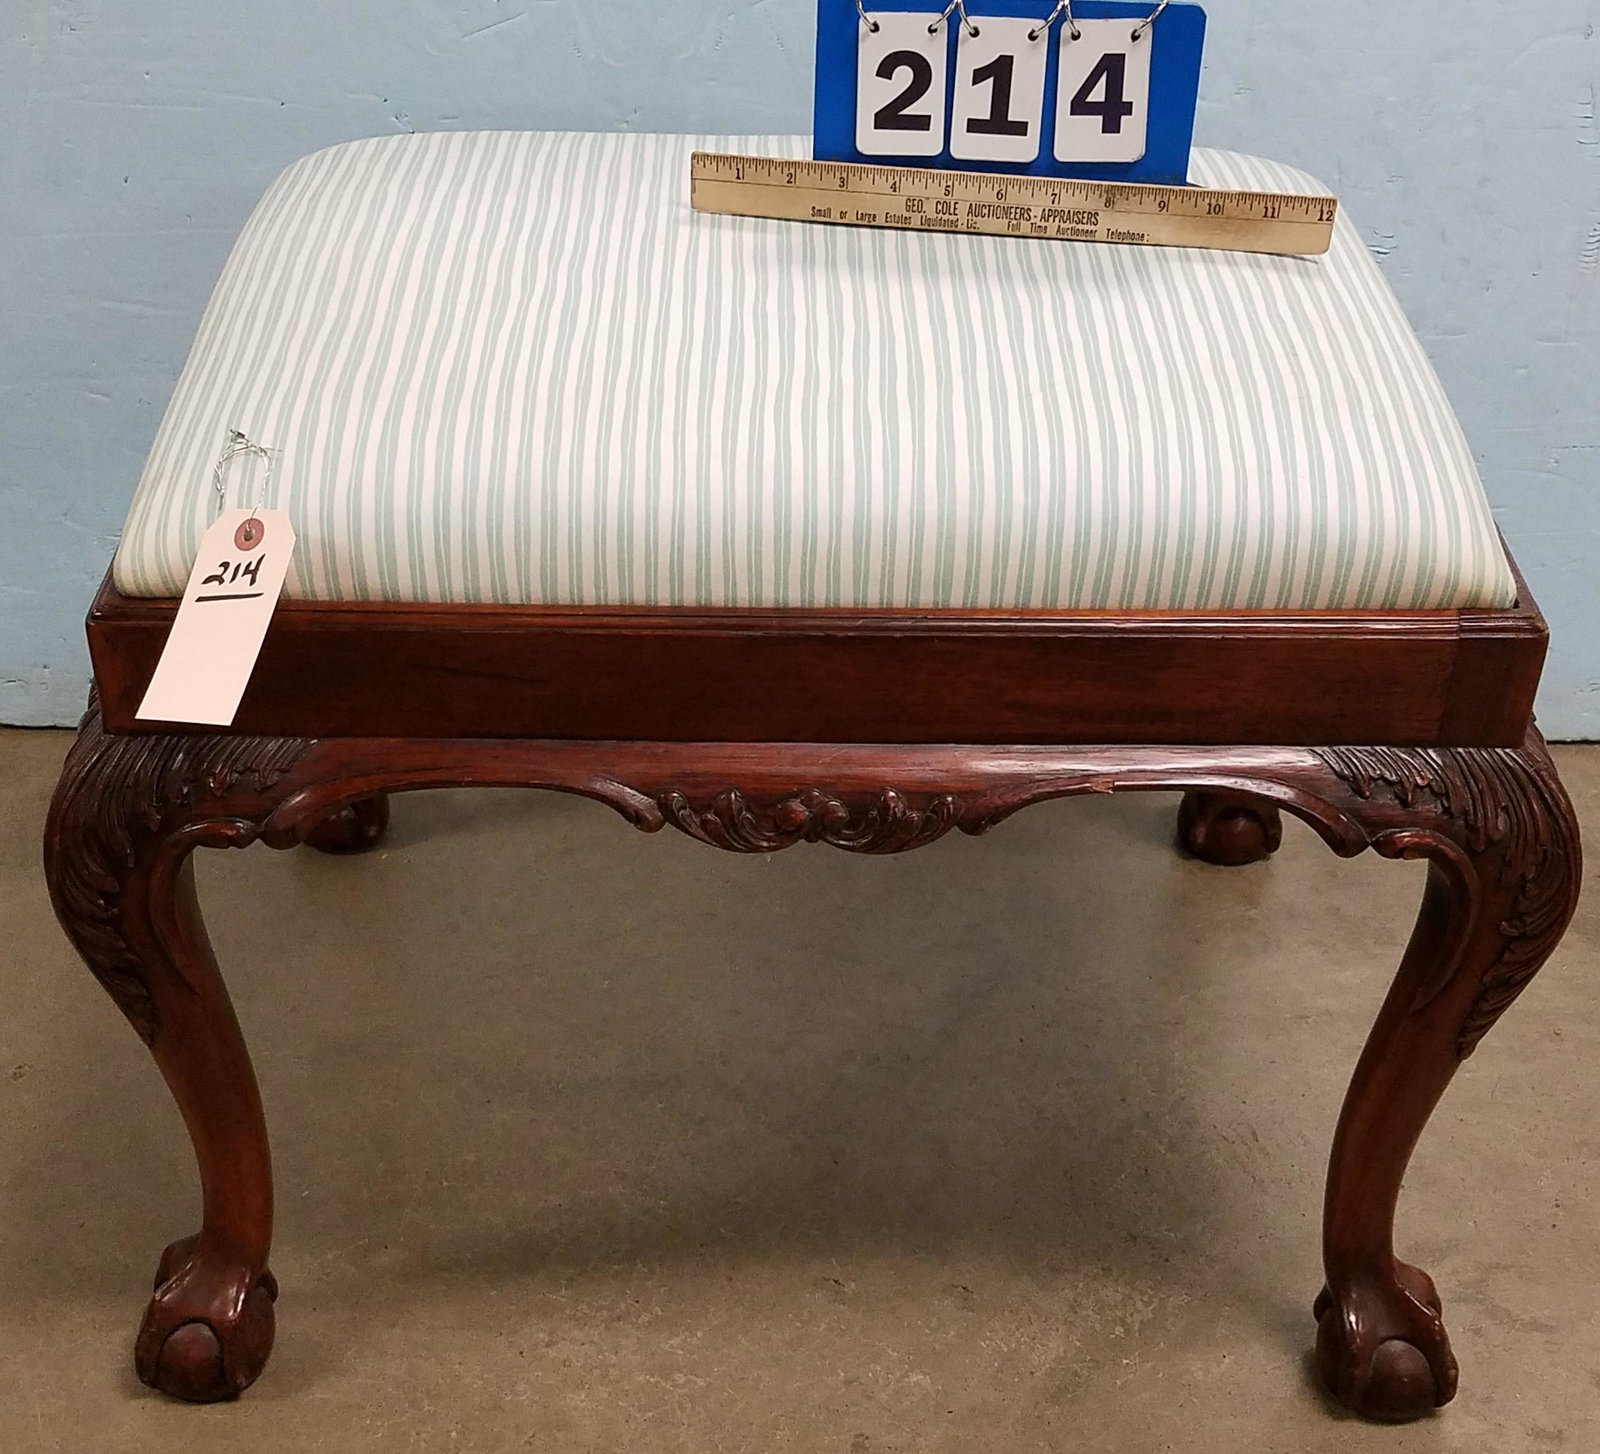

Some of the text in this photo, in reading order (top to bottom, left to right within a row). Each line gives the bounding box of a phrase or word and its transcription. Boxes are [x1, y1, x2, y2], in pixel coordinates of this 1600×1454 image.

[735, 167, 1333, 222] 1 2 3 4 5 6 7 8 9 10 11 12
[905, 197, 926, 214] GEO.
[935, 200, 959, 216] COLE
[811, 206, 832, 219] Small
[839, 210, 848, 220] or
[856, 210, 877, 223] Large
[885, 212, 912, 225] Estates
[1007, 221, 1022, 232] Full
[1030, 222, 1048, 234] Time
[1056, 225, 1098, 238] Auctioneer
[201, 553, 266, 586] 214
